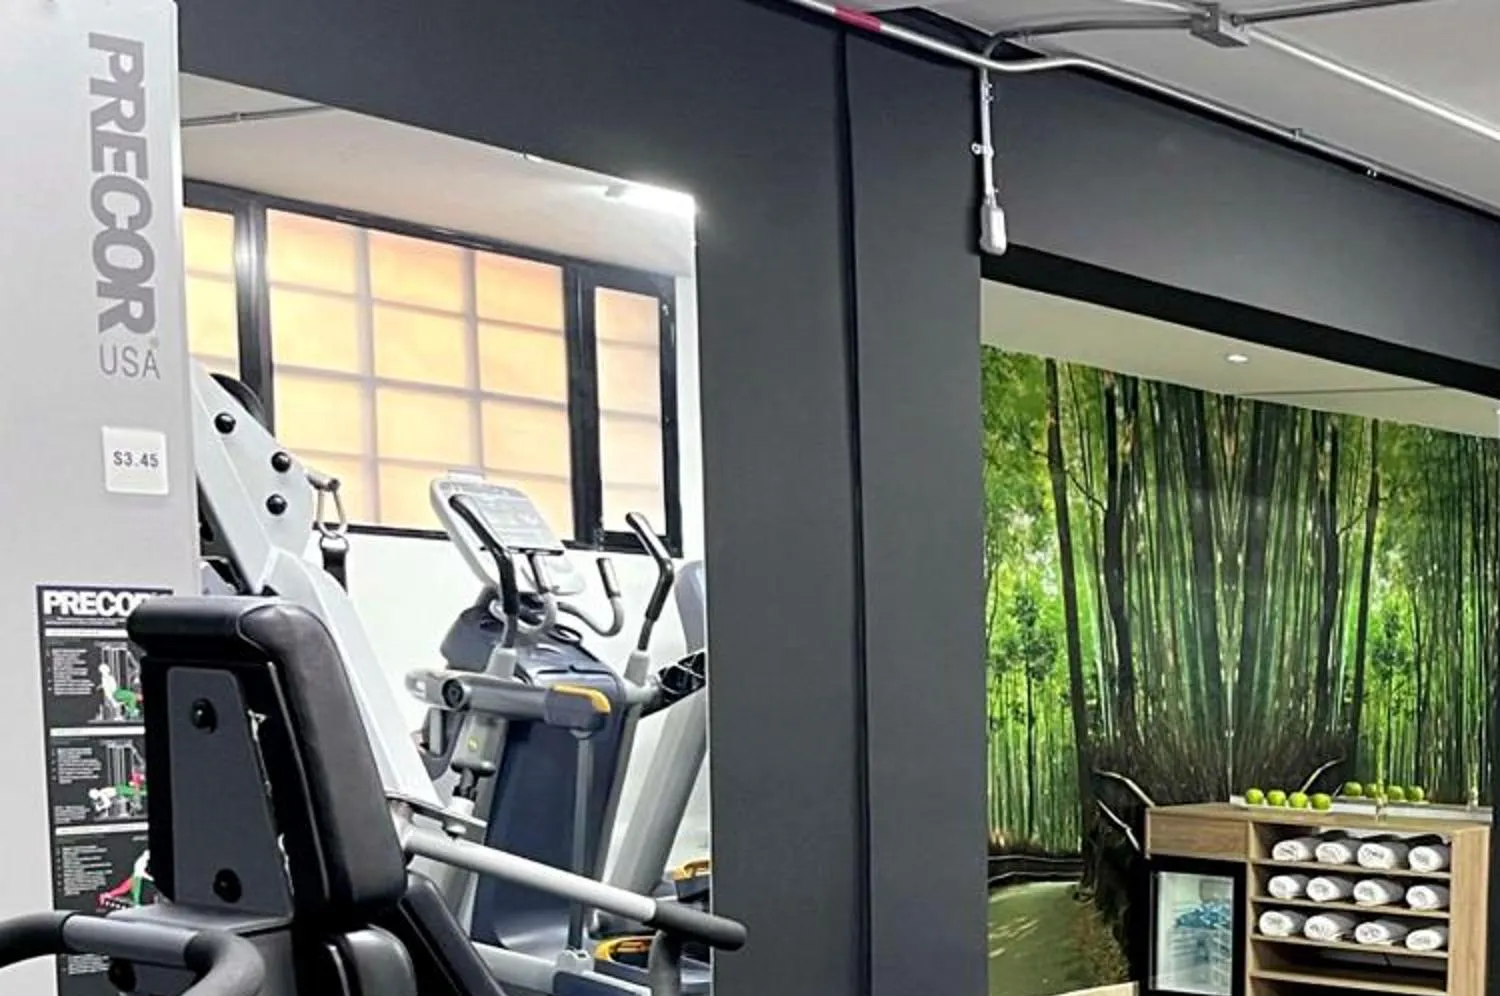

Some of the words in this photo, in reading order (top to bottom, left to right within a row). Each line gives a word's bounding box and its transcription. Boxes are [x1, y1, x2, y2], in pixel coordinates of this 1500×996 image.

[89, 32, 156, 335] PRECOR
[101, 346, 160, 380] USA
[43, 590, 150, 617] PRECO
